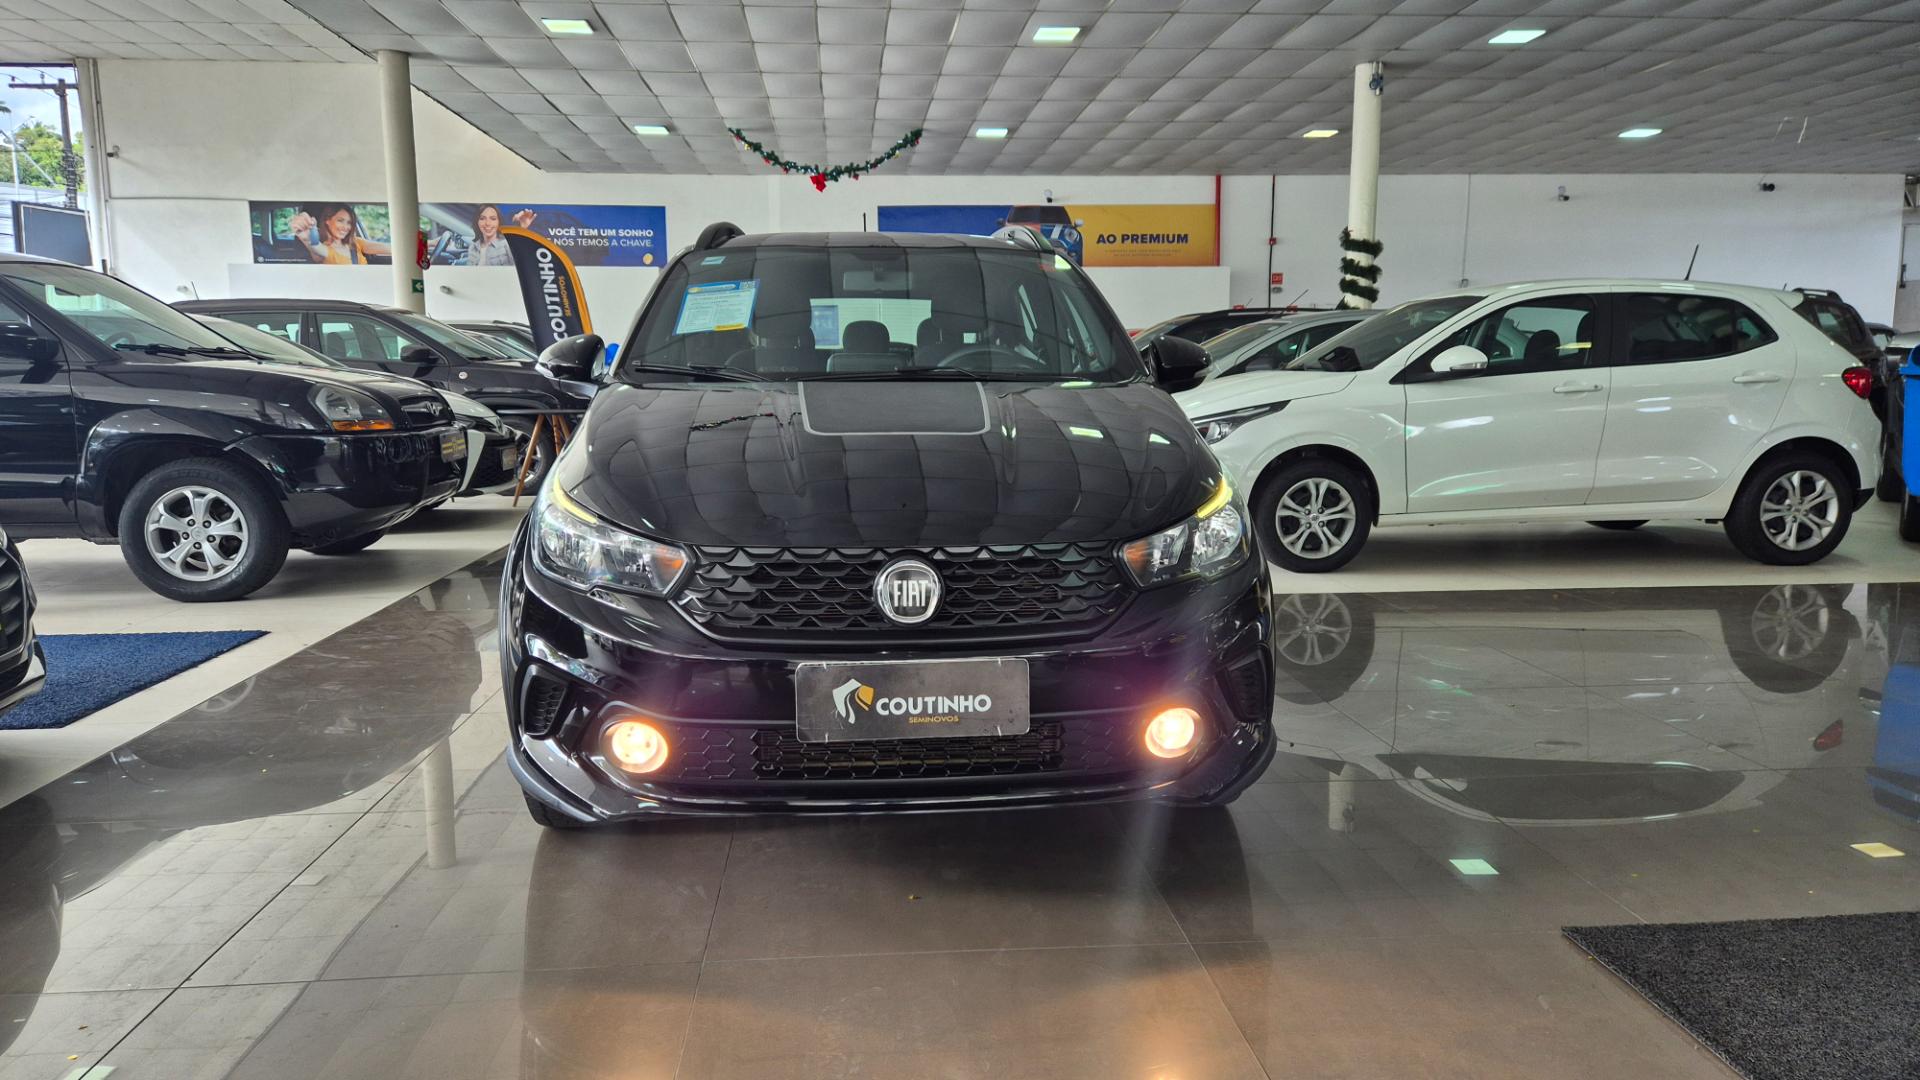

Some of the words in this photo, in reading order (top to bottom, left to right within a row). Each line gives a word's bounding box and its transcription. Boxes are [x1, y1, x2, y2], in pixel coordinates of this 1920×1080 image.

[548, 226, 576, 236] VOCÊ
[578, 228, 598, 237] TEM
[600, 228, 616, 237] UM
[618, 228, 654, 237] SONHO
[553, 236, 575, 247] NÓS
[577, 238, 609, 247] TEMOS
[611, 239, 618, 247] A
[1096, 233, 1117, 244] AO
[1121, 233, 1189, 244] PREMIUM
[536, 248, 568, 341] COUTINHO
[893, 580, 928, 607] FIAT
[876, 694, 992, 716] COUTINHO
[908, 715, 959, 723] SEMINOVOS
